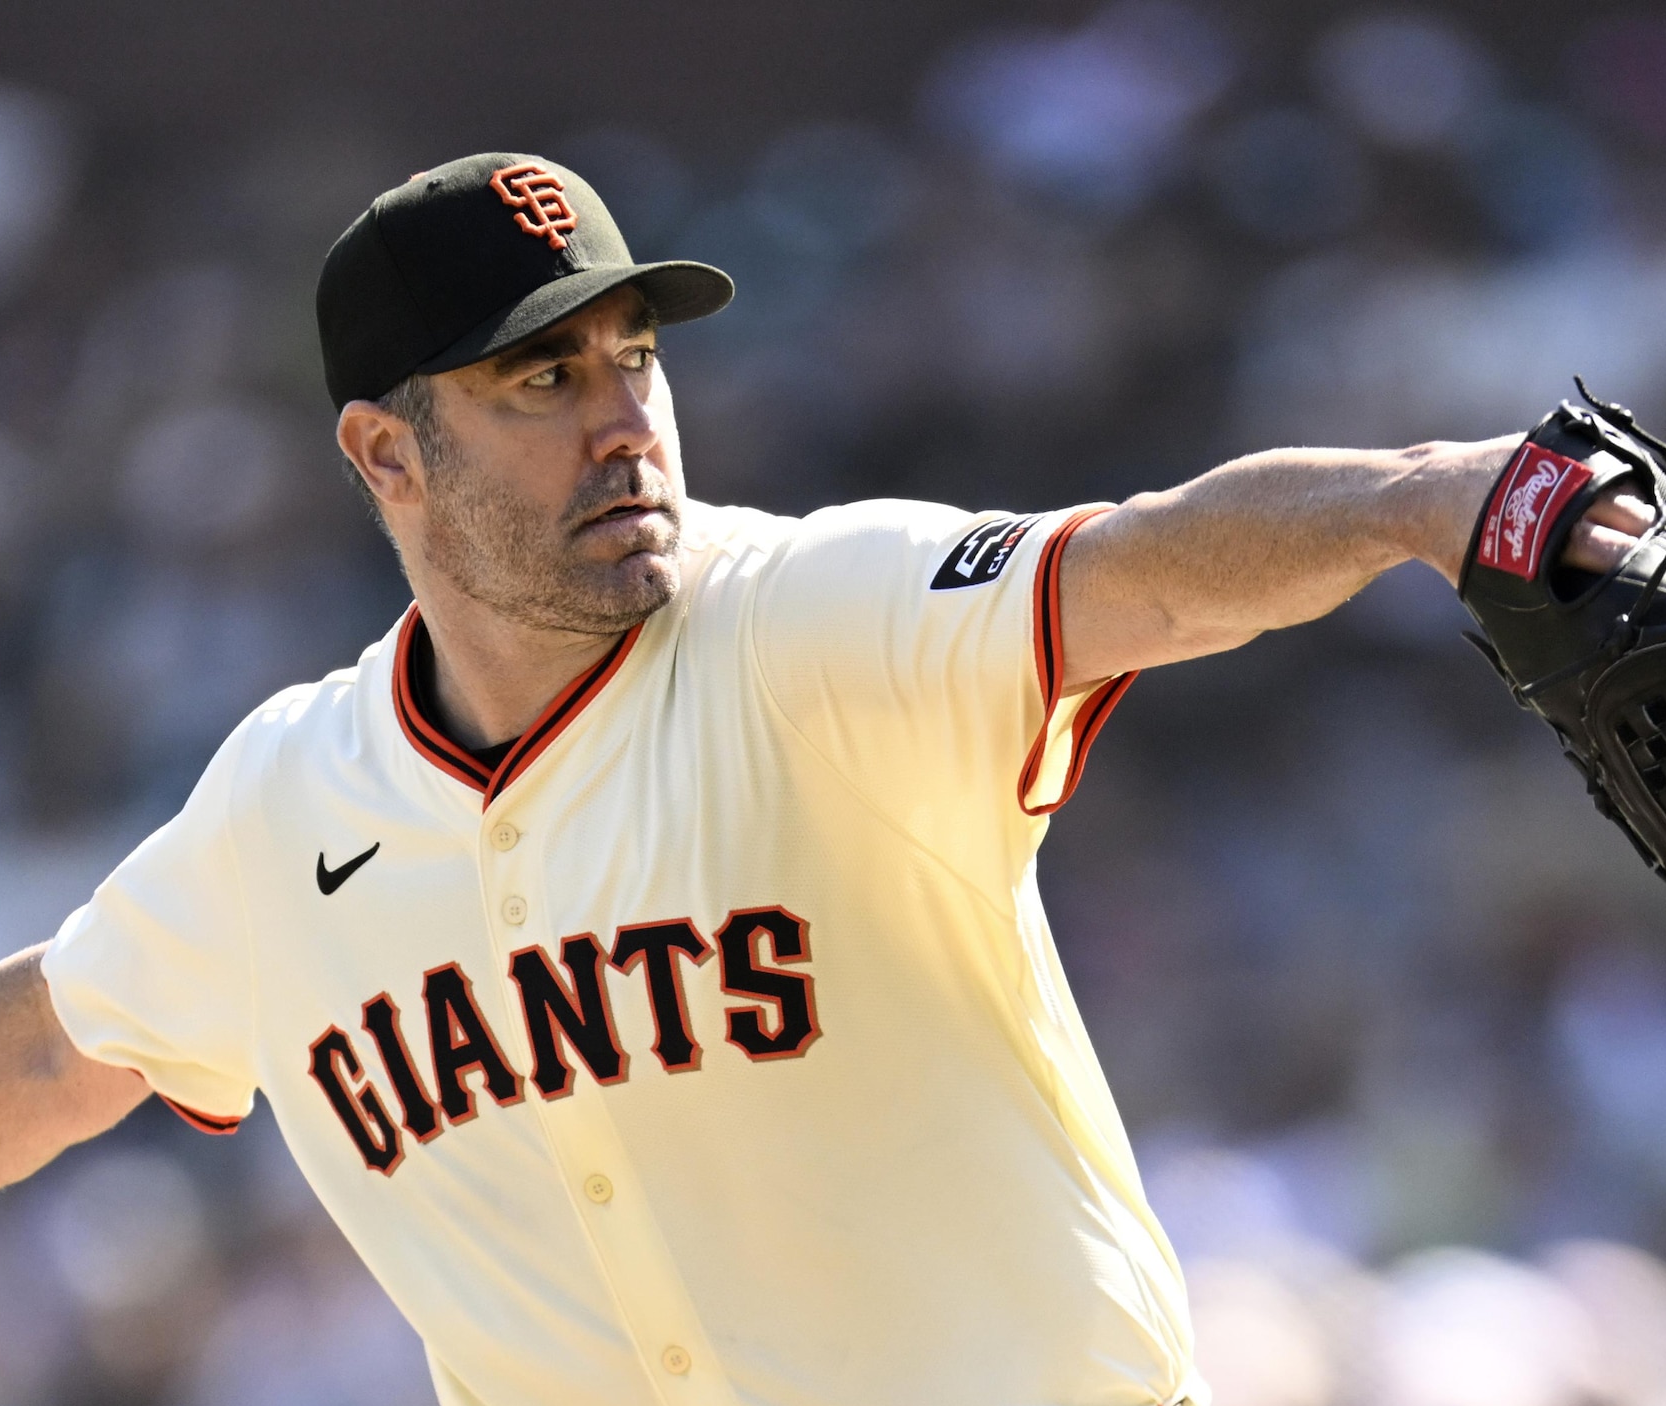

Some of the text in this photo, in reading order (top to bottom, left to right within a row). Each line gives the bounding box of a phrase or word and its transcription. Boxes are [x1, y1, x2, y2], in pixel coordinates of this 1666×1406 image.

[489, 161, 578, 250] SF
[1504, 460, 1558, 561] Rawlings
[308, 904, 823, 1177] GIANTS
